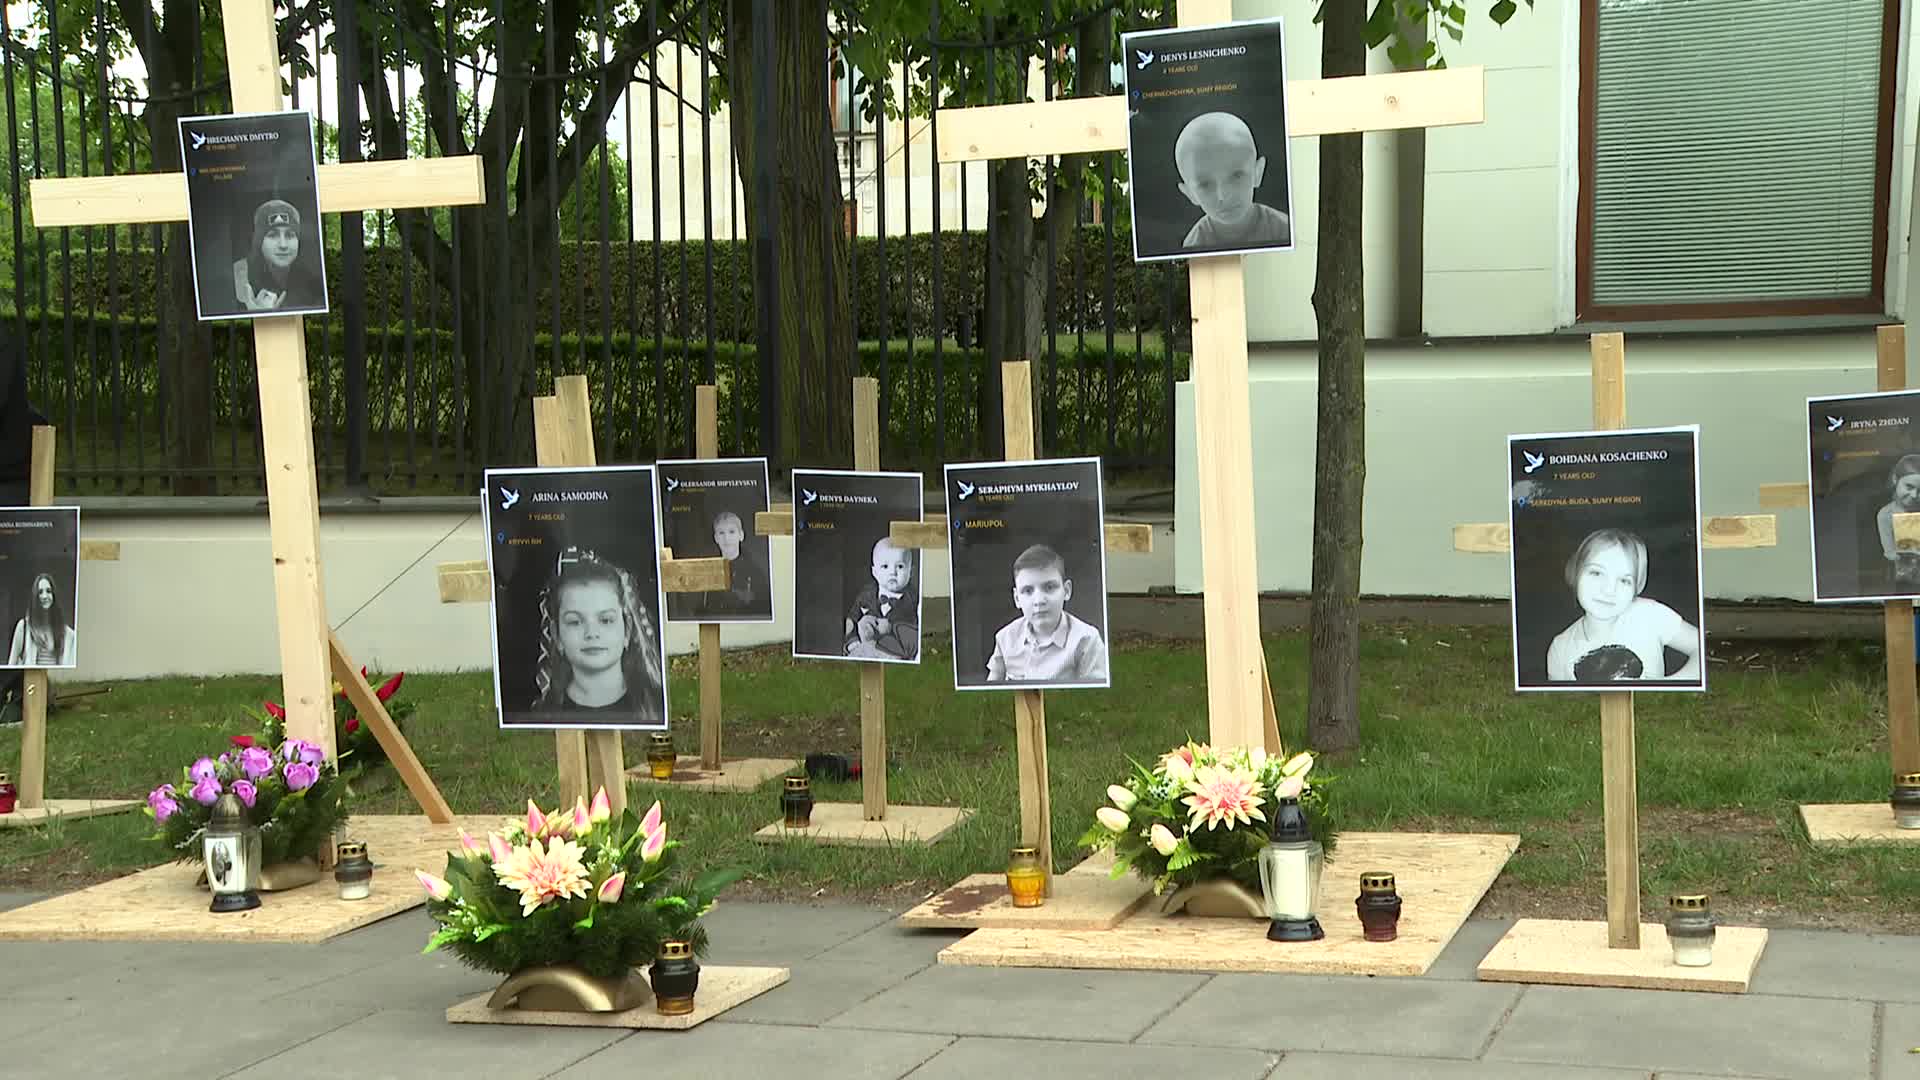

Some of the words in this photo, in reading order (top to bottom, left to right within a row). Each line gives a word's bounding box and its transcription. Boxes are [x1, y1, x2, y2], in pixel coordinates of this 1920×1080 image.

[1160, 52, 1188, 63] DENYS
[1188, 46, 1247, 59] LESNICHENKO
[249, 132, 279, 141] DMYTRO
[1850, 420, 1878, 429] IRYNA
[1878, 417, 1910, 426] ZHDAN
[1549, 453, 1598, 465] BOHDANA
[1599, 450, 1668, 463] KOSACHENKO
[978, 484, 1024, 495] SERAPHYM
[1025, 481, 1080, 494] MYKHAYLOV
[532, 492, 560, 502] ARINA
[560, 491, 609, 501] SAMODINA
[843, 495, 878, 504] DAYNEKA
[1613, 495, 1641, 504] REGION
[965, 519, 1004, 529] MARIUPOL
